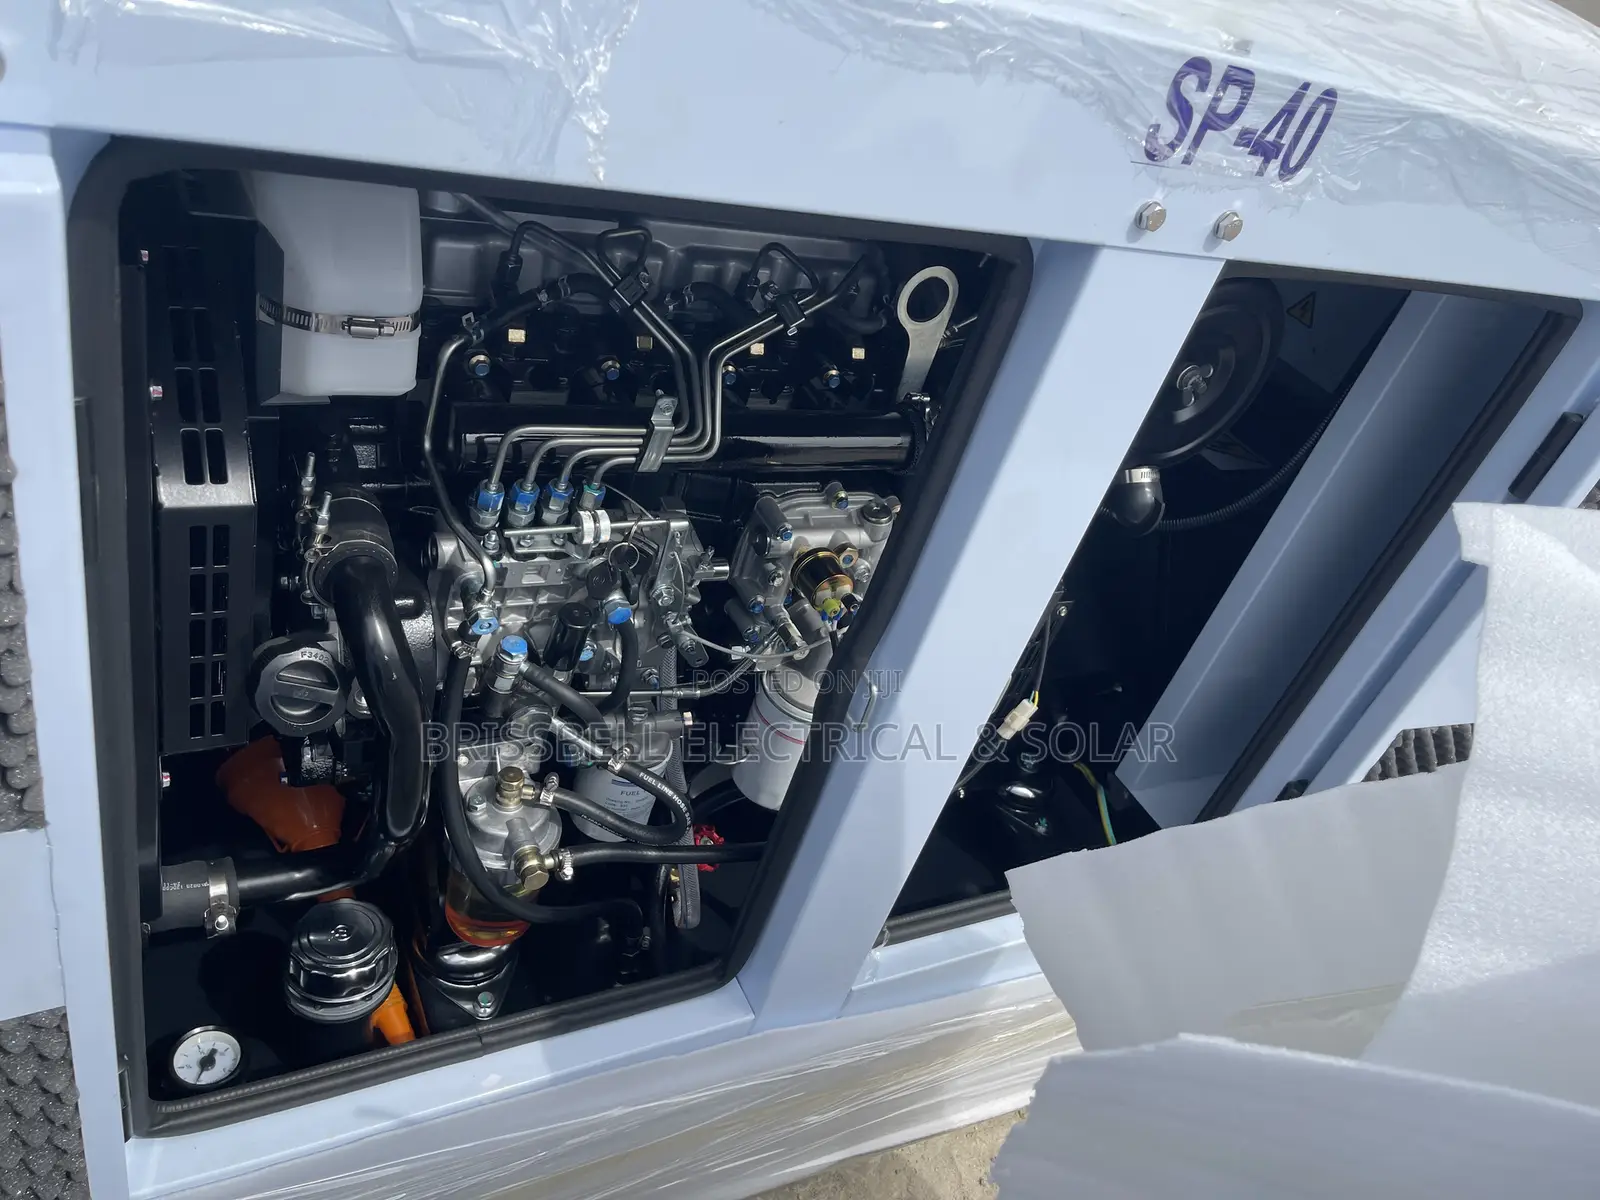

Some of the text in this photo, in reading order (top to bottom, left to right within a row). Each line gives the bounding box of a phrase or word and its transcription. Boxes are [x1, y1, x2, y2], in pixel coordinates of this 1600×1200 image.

[1144, 56, 1338, 182] SP-40
[639, 772, 656, 786] FUEL
[657, 783, 674, 797] LINE
[672, 794, 688, 813] HOSE
